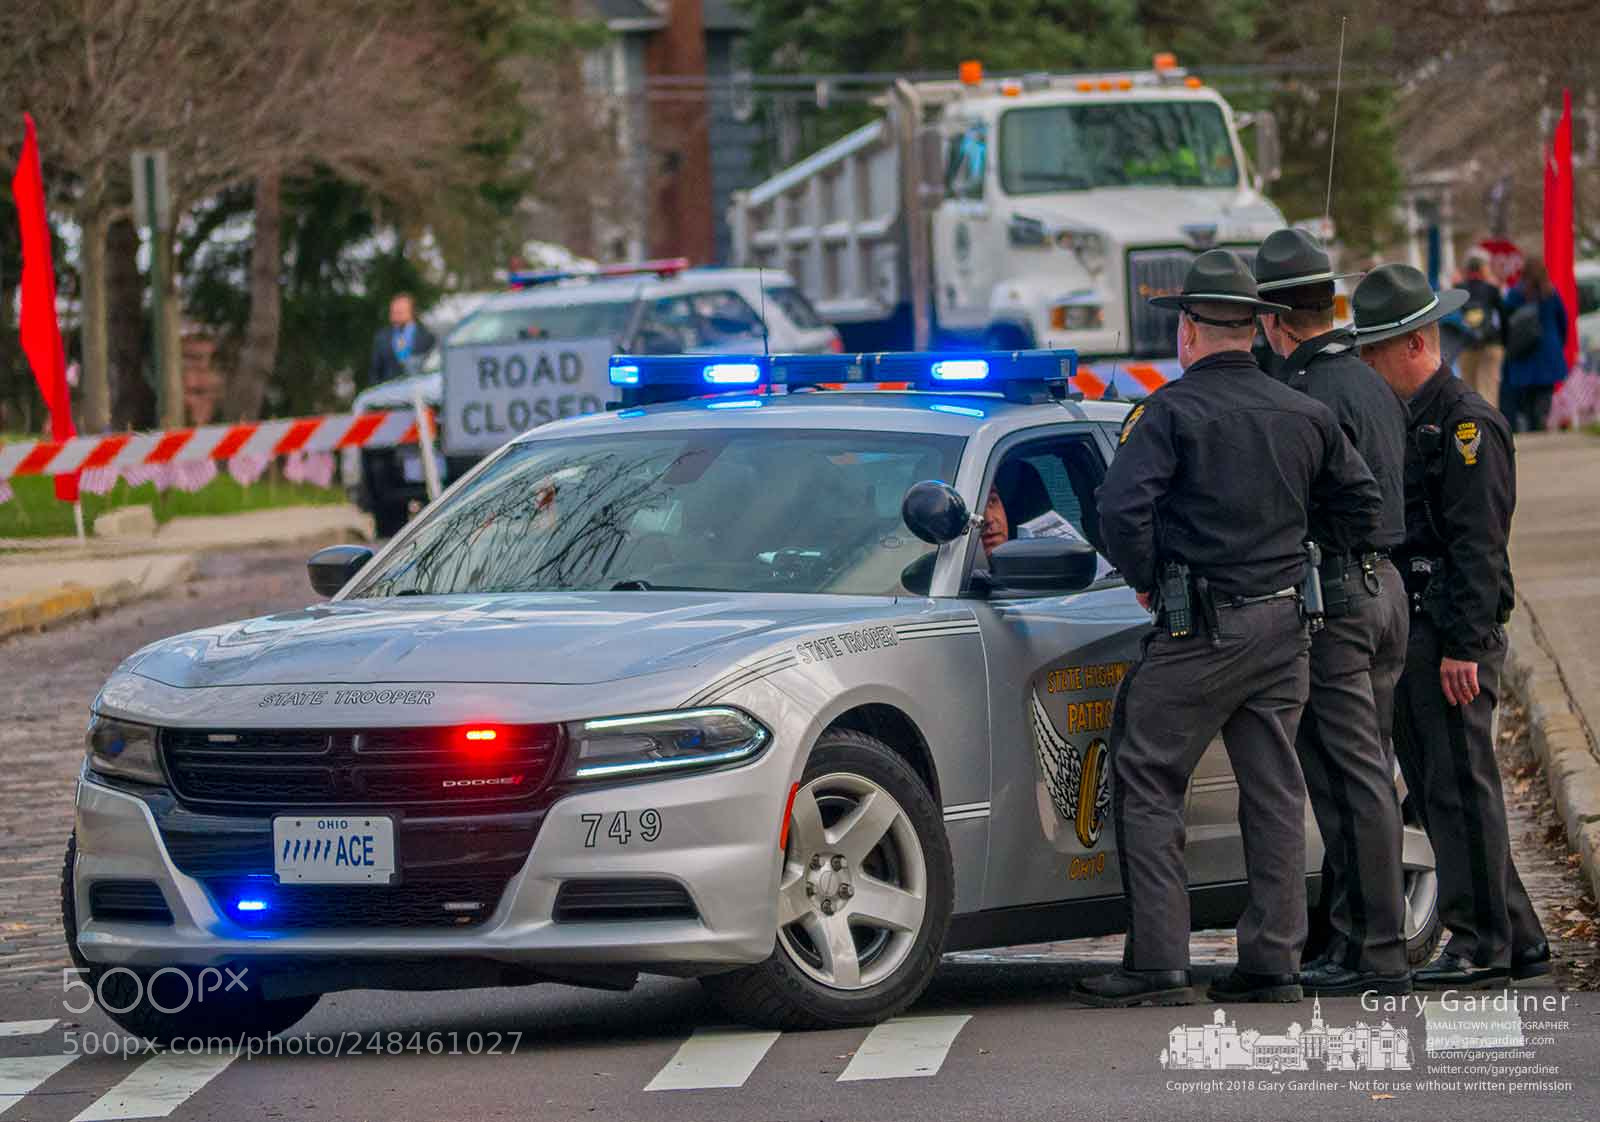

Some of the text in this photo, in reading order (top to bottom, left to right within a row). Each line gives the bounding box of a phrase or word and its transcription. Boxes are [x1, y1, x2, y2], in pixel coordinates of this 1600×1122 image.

[477, 351, 584, 389] ROAD
[796, 625, 898, 664] STATE TROOPER
[1047, 662, 1127, 693] STATE HIGHW
[258, 689, 436, 707] STATE TROOPER
[1067, 699, 1112, 735] PATRO
[442, 777, 514, 787] DODGE
[318, 820, 348, 829] OHIO
[581, 808, 662, 848] 749
